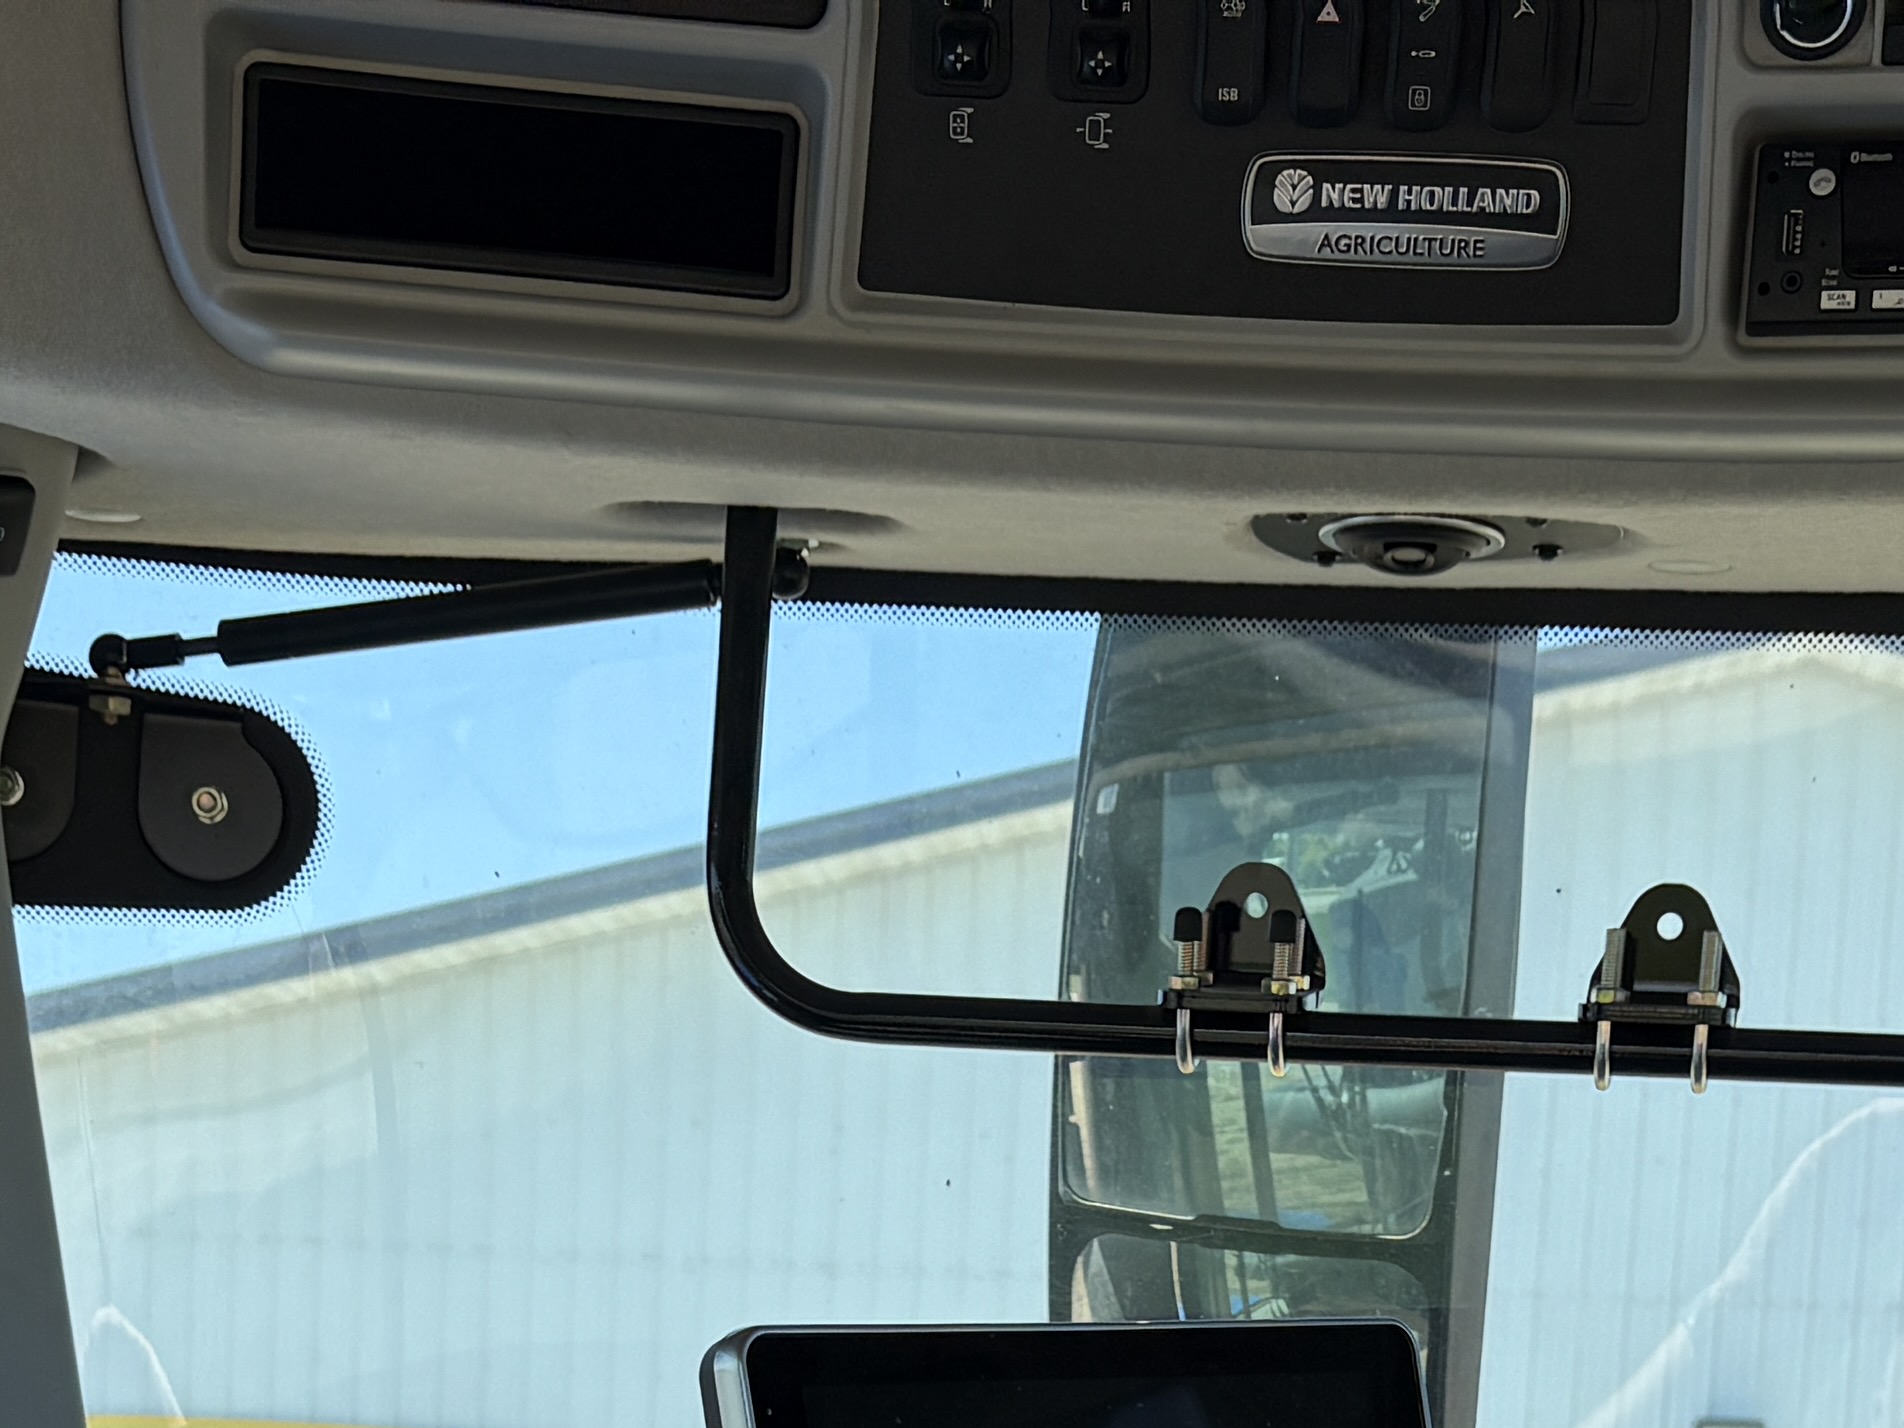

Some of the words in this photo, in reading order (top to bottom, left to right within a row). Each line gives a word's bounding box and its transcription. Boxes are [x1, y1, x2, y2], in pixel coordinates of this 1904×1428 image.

[1218, 87, 1238, 102] ISB
[1321, 181, 1392, 212] NEW
[1398, 185, 1542, 216] HOLLAND
[1316, 231, 1487, 261] AGRICULTURE
